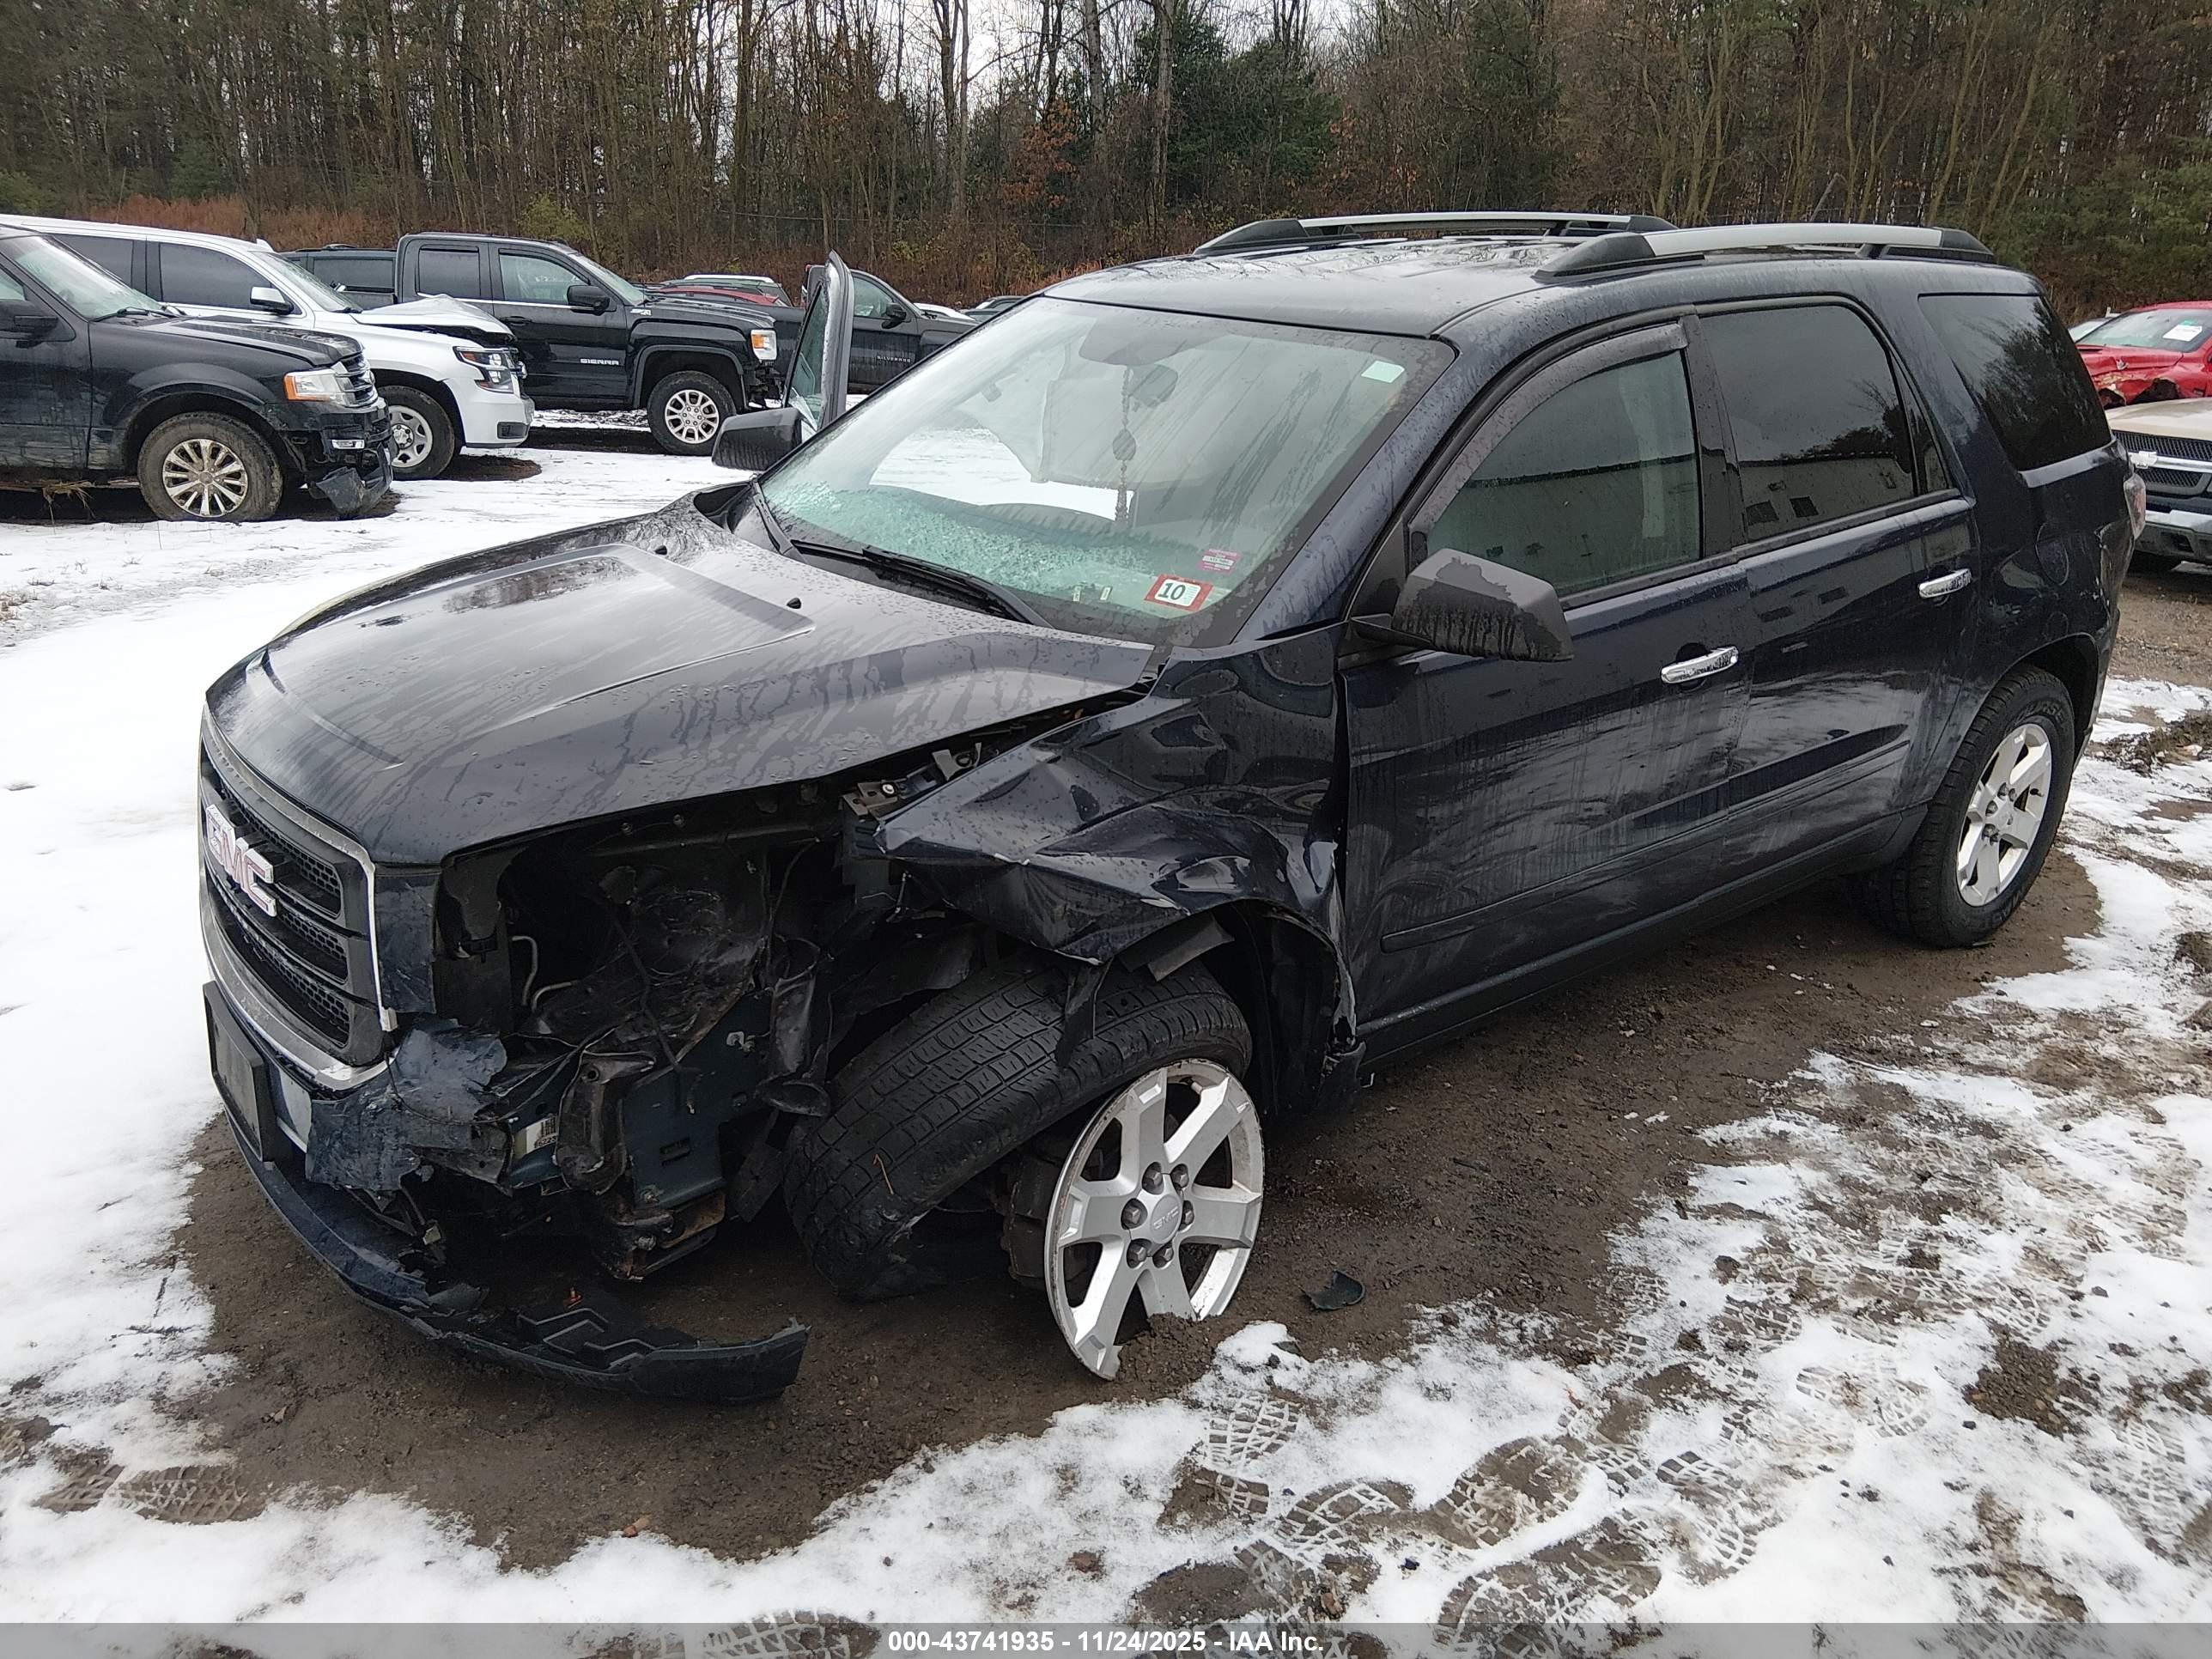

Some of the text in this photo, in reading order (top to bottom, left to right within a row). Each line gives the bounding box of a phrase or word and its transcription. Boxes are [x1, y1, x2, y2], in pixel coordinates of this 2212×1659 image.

[1158, 583, 1186, 600] 10
[205, 804, 277, 917] GMC
[1153, 1206, 1179, 1230] GMC
